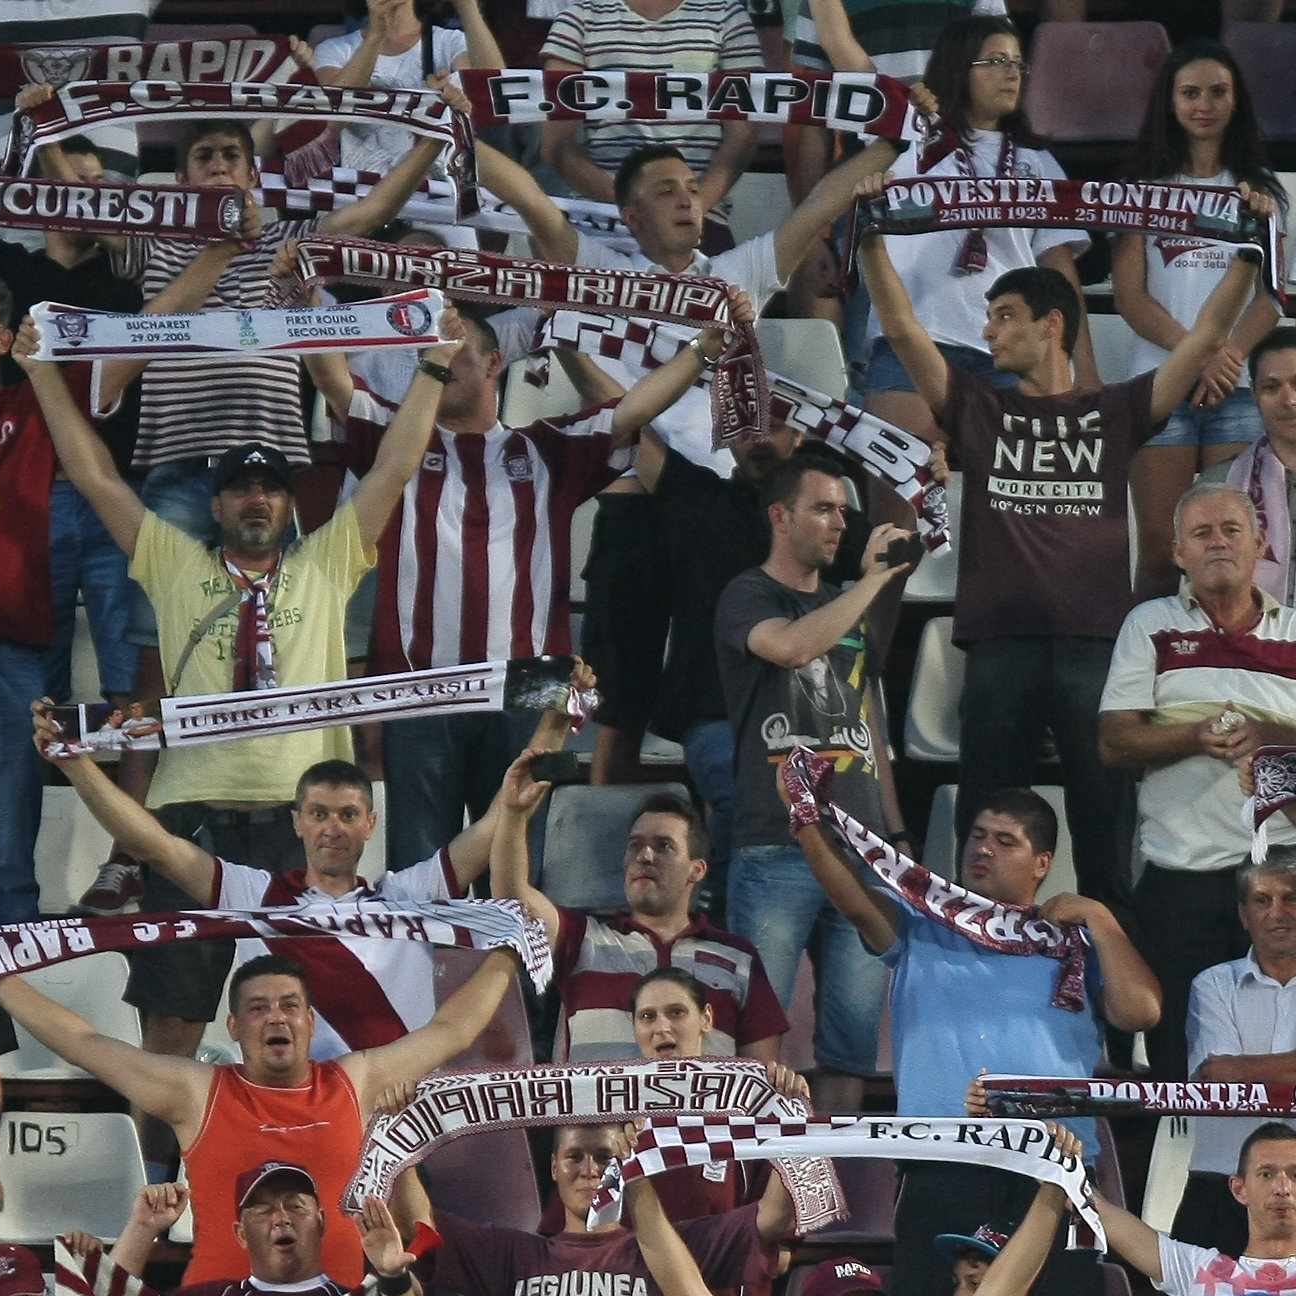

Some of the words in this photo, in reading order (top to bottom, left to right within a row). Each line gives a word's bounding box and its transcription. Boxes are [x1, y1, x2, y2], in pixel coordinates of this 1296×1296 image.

[490, 74, 635, 116] F.C.
[655, 75, 886, 126] RAPID
[886, 180, 1058, 211] POVESTEA
[1006, 207, 1048, 221] 1923
[1075, 208, 1096, 222] 25
[1101, 210, 1144, 226] IUNIE
[1148, 213, 1189, 231] 2014
[298, 240, 544, 300] FORZA
[125, 319, 192, 331] BUCHAREST
[993, 436, 1103, 474] NEW
[996, 481, 1046, 497] YORK
[1052, 481, 1098, 498] CITY
[866, 1122, 943, 1141] F.C.
